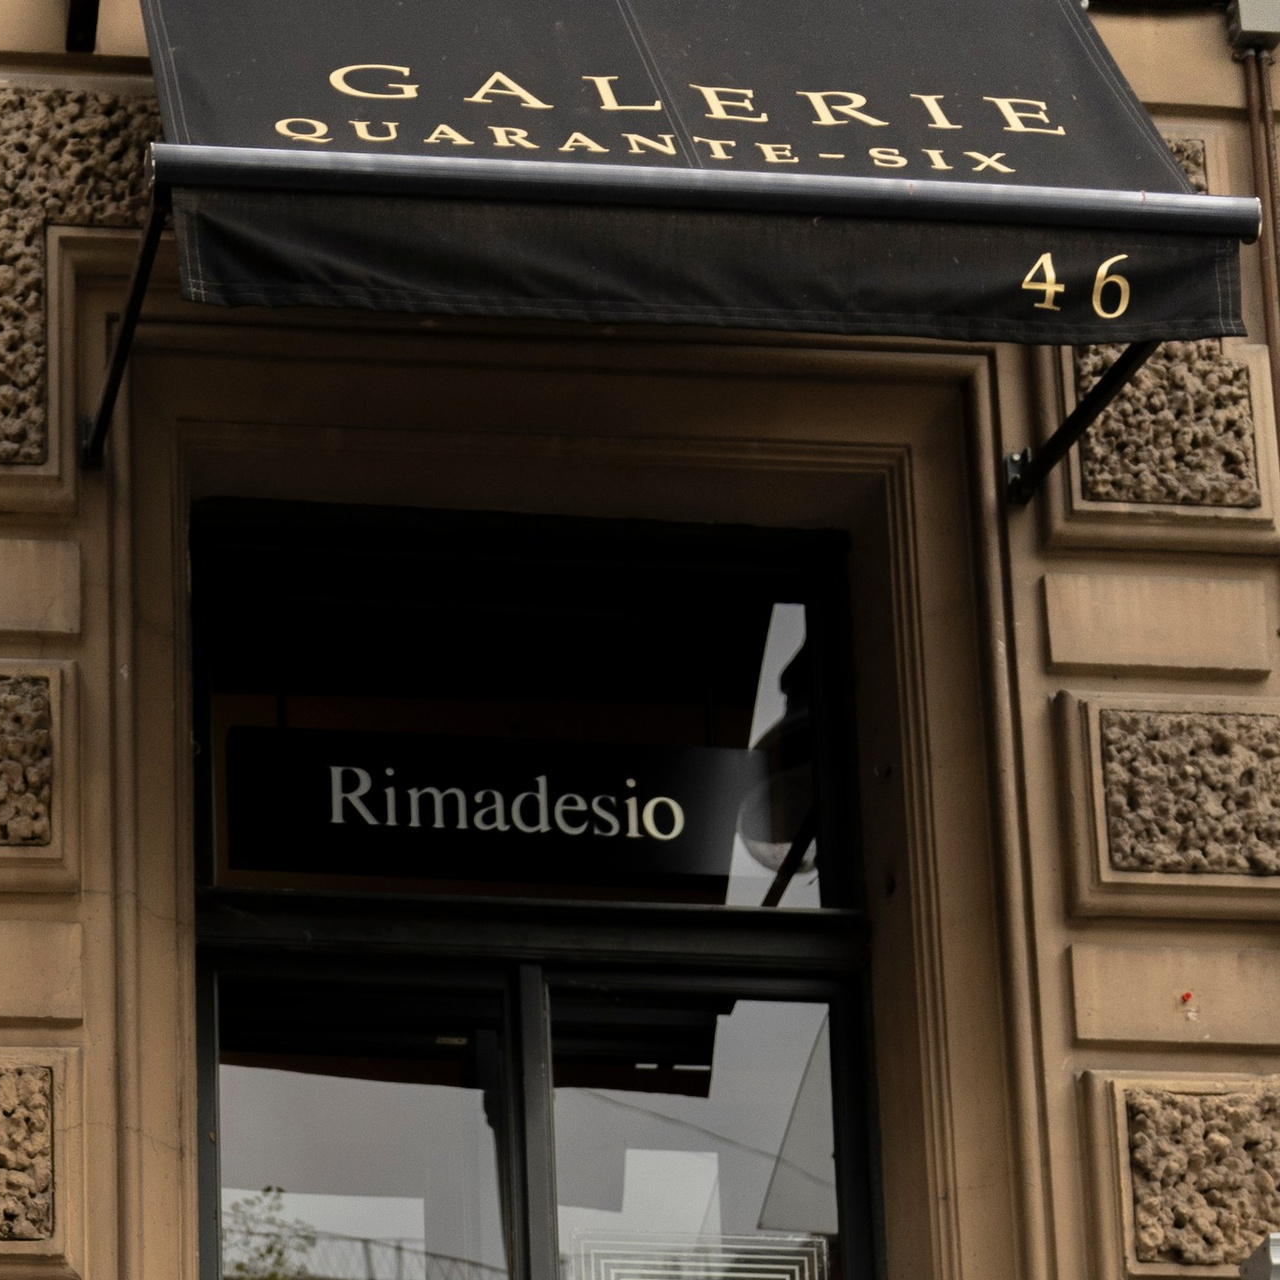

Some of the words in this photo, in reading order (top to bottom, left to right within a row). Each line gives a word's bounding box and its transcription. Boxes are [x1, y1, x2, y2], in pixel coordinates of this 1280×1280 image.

[328, 63, 1066, 136] GALERIE
[274, 117, 1017, 173] QUARANTE-SIX
[1021, 252, 1131, 320] 46
[329, 764, 686, 842] Rimadesio
